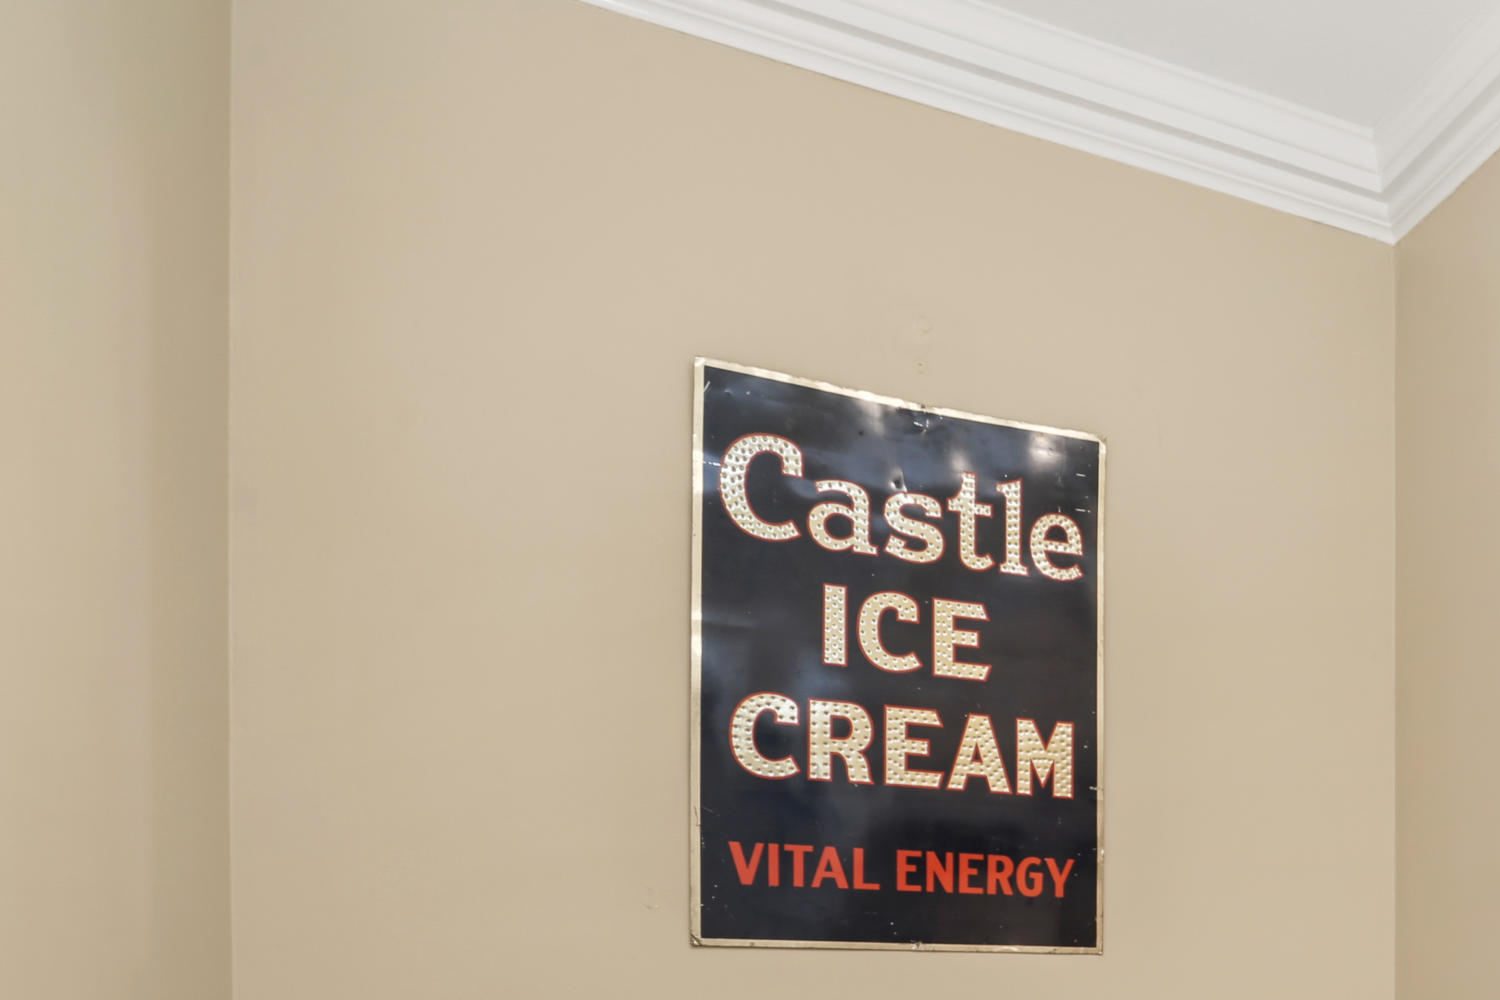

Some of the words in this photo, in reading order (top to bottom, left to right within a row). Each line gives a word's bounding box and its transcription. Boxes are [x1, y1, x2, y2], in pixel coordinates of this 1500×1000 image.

[719, 432, 1085, 582] Castle
[822, 583, 993, 682] ICE
[729, 691, 1075, 799] CREAM
[728, 841, 880, 891] VITAL
[896, 850, 1075, 899] ENERGY
